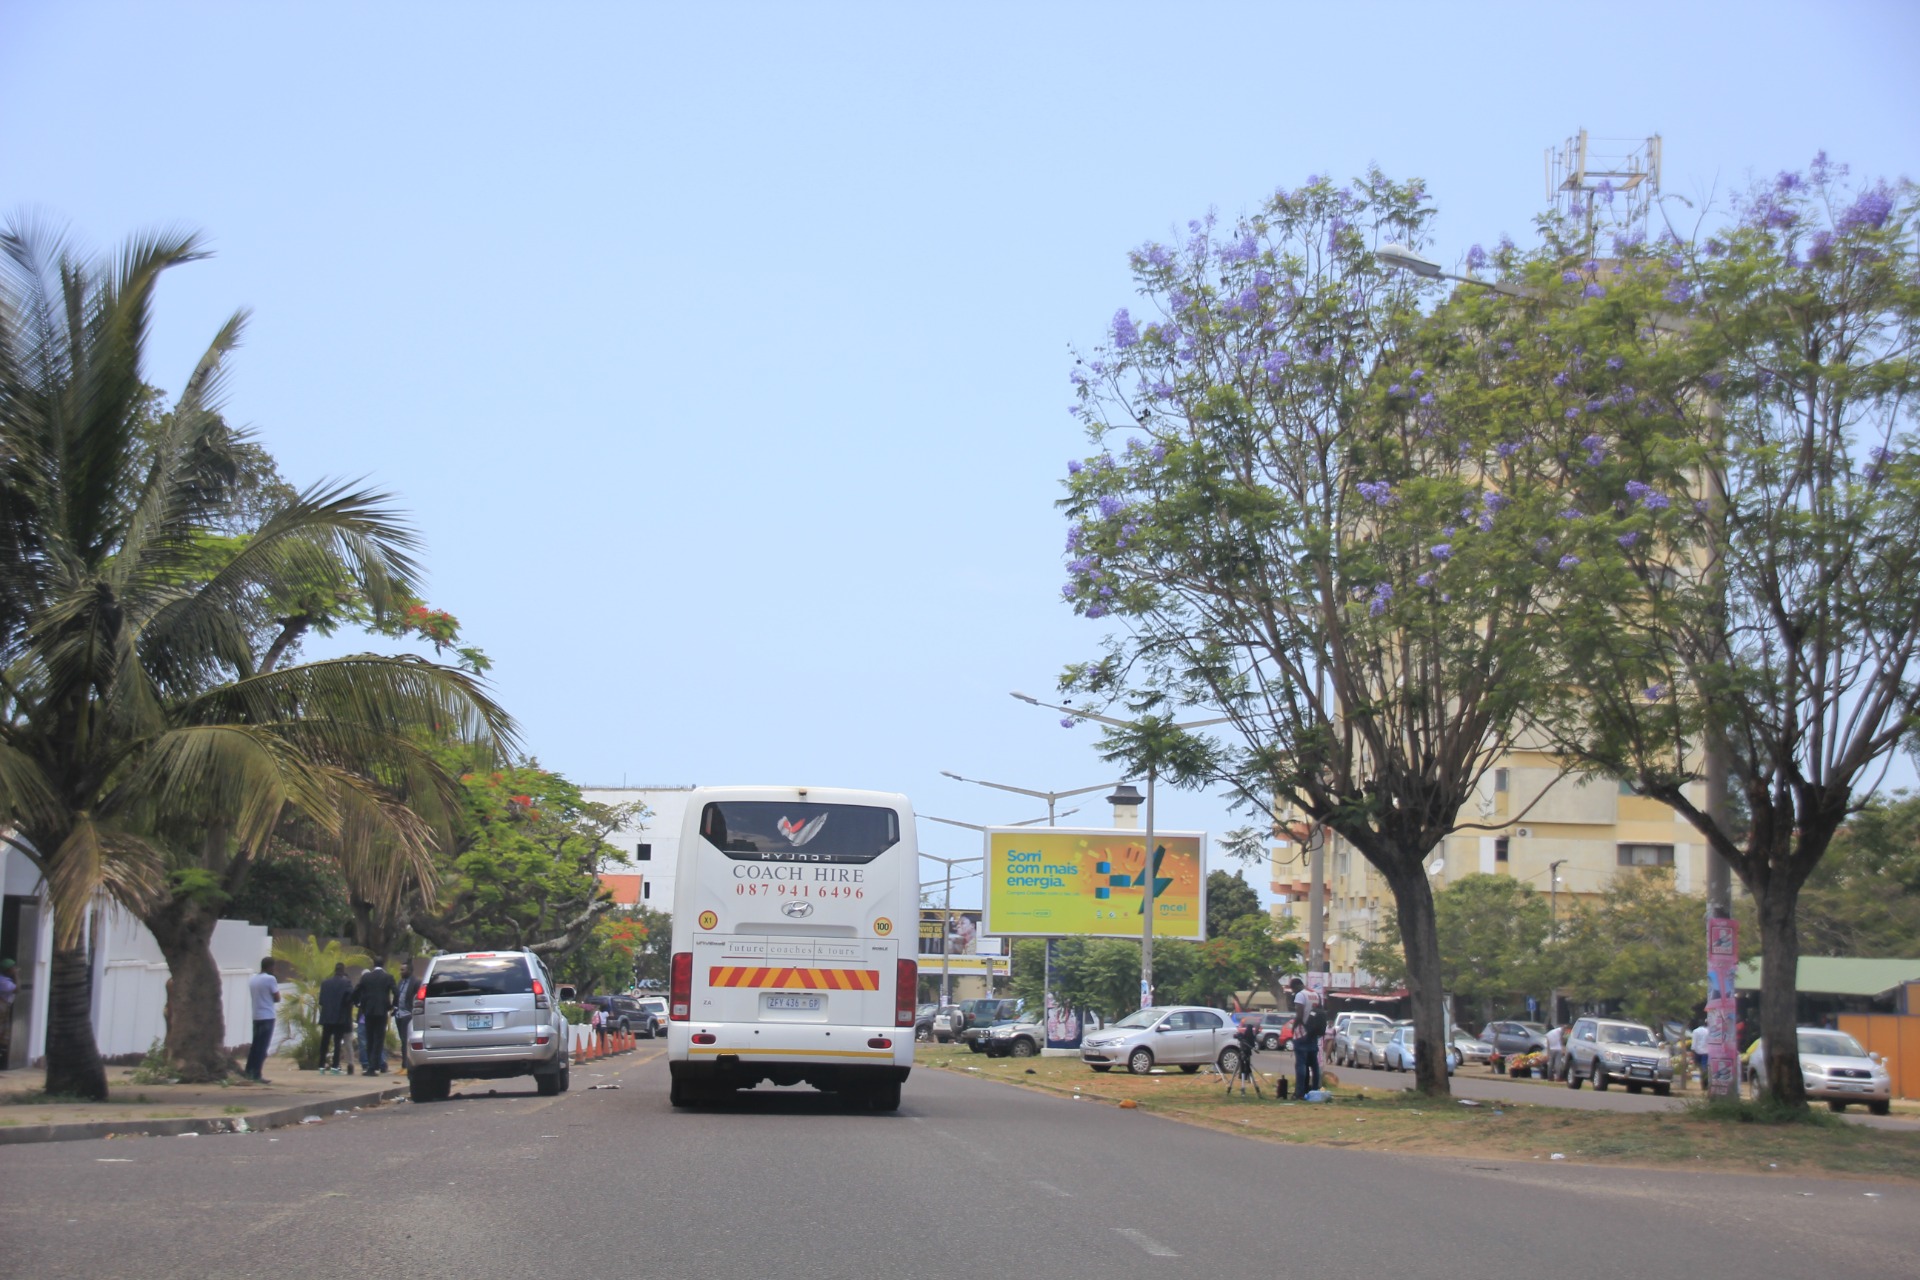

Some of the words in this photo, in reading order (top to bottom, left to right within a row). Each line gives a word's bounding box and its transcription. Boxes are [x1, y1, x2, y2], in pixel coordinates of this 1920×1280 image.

[1007, 849, 1042, 862] Sorri
[732, 864, 803, 881] COACH
[814, 867, 865, 883] HIRE
[1007, 864, 1040, 874] com
[1043, 861, 1079, 875] mais
[1007, 874, 1066, 889] energia.
[736, 883, 769, 896] 087
[777, 884, 809, 897] 941
[818, 885, 864, 899] 6496
[1160, 903, 1187, 912] mcel
[877, 922, 890, 931] 100
[729, 944, 765, 953] future
[770, 945, 812, 954] coaches
